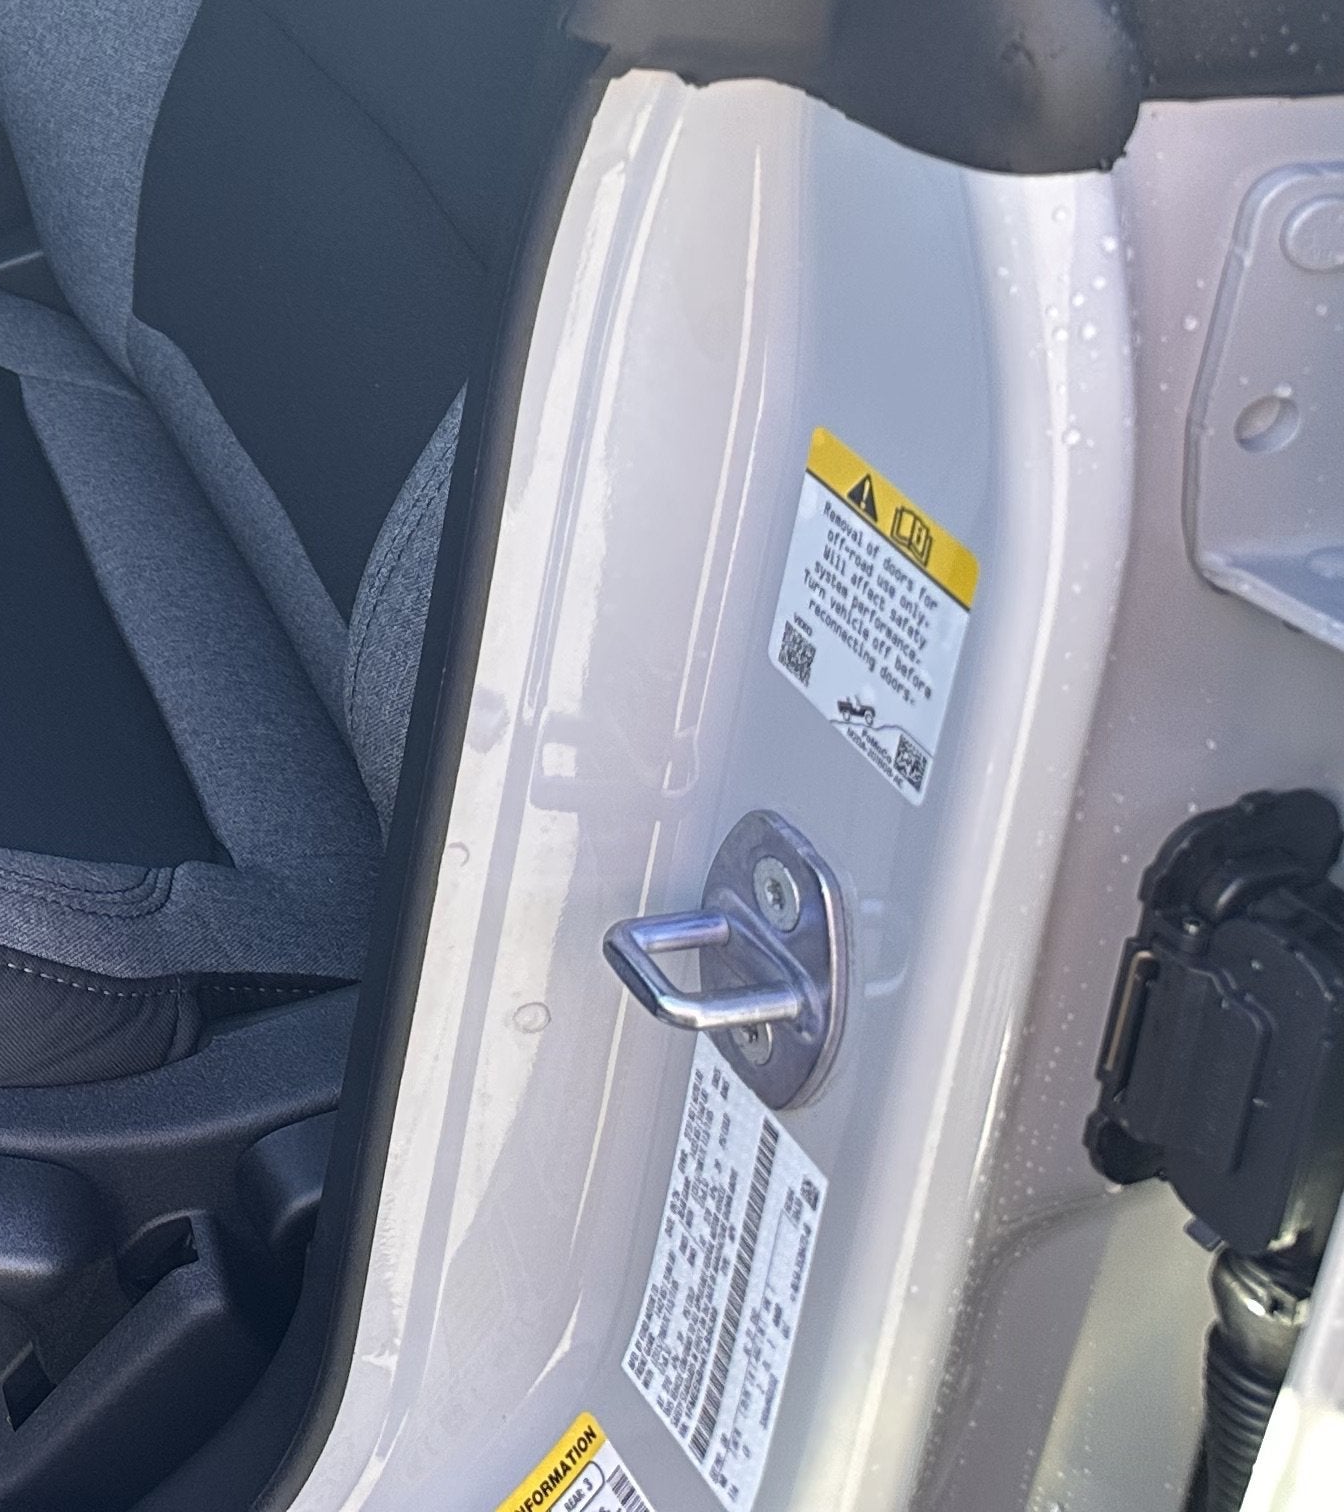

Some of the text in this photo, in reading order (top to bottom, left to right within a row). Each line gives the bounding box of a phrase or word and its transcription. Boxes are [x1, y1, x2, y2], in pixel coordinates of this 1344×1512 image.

[823, 501, 938, 612] Removal of doors for
[823, 545, 926, 650] Will affect safety
[827, 527, 930, 631] off-road use only.
[803, 569, 932, 698] Turn vehicle off before
[808, 598, 915, 706] reconnecting doors.
[814, 560, 921, 666] system performance.
[582, 1477, 593, 1491] 3
